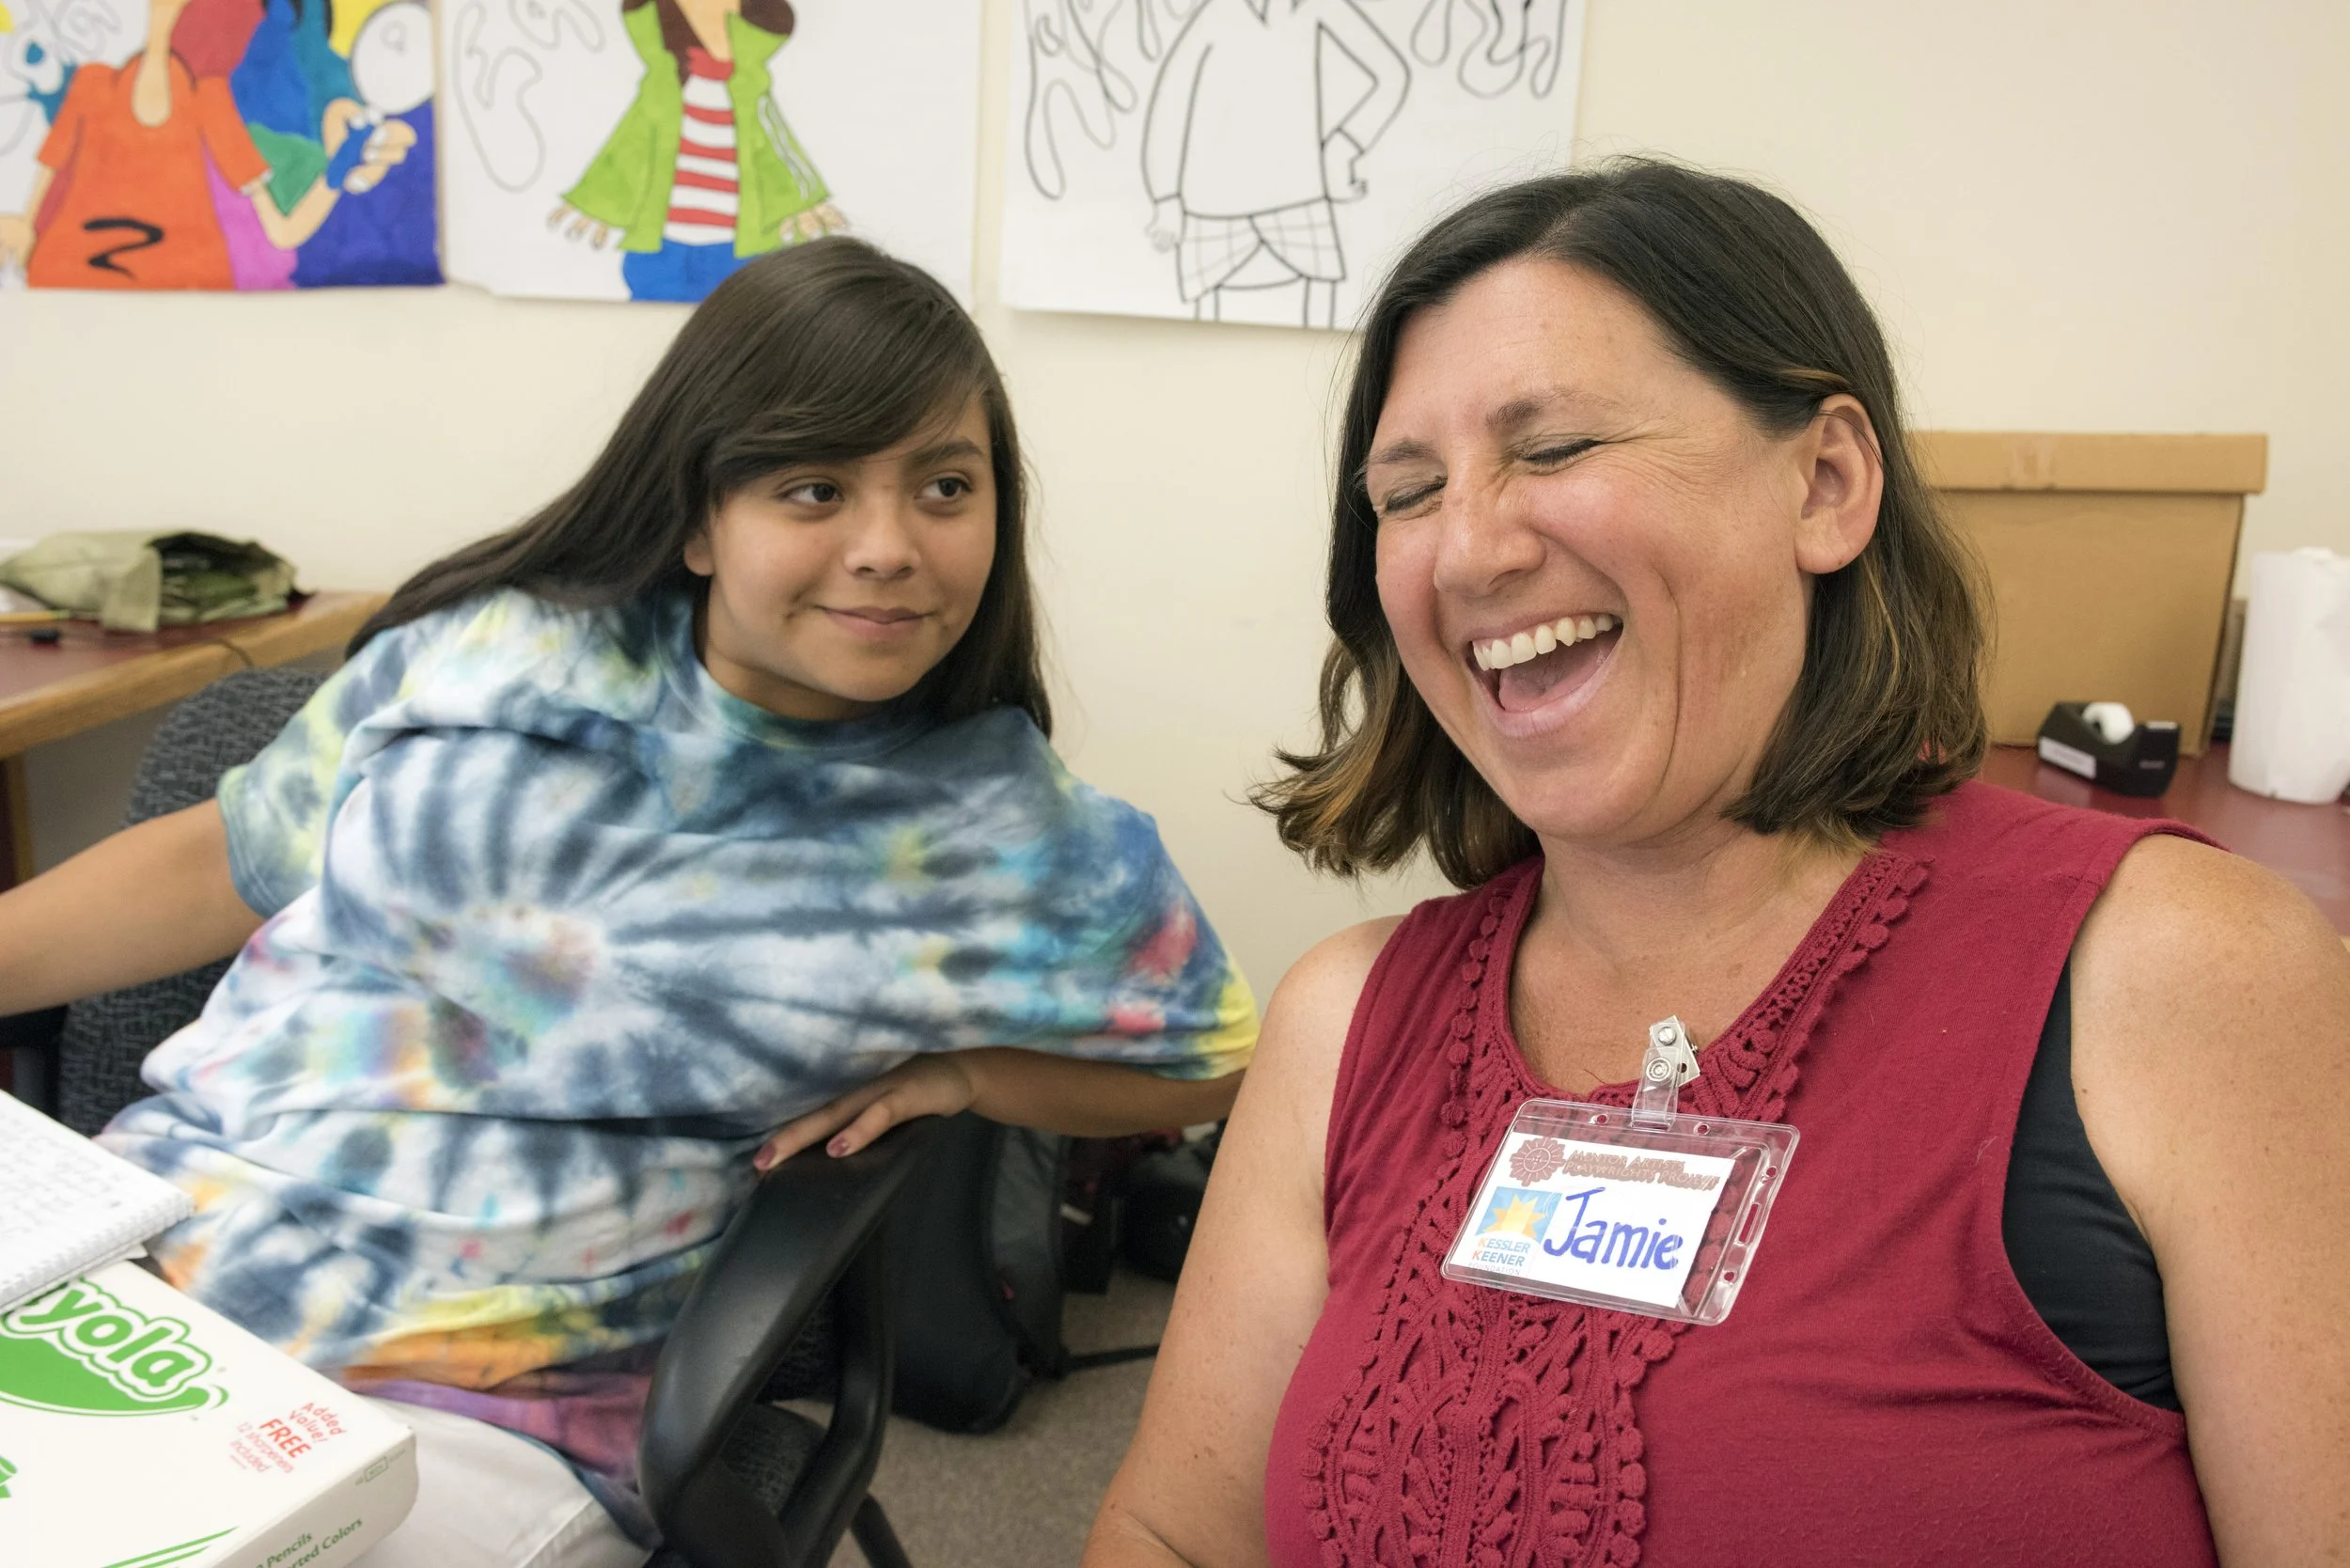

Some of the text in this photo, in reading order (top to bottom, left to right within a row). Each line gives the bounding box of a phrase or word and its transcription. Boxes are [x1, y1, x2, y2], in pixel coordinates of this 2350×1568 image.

[1565, 1162, 1656, 1182] PLAYWRIGHTS
[1569, 1149, 1685, 1171] MENTOR ARTISTS
[1543, 1187, 1683, 1270] Jamie
[1472, 1249, 1526, 1267] KEENER
[1478, 1237, 1531, 1254] KESSLER
[1468, 1262, 1521, 1276] FOUNDATION
[18, 1281, 196, 1388] yola
[301, 1402, 347, 1435] Added
[259, 1418, 312, 1458] FREE
[267, 1532, 312, 1568] Pencils
[321, 1517, 363, 1550] Colors
